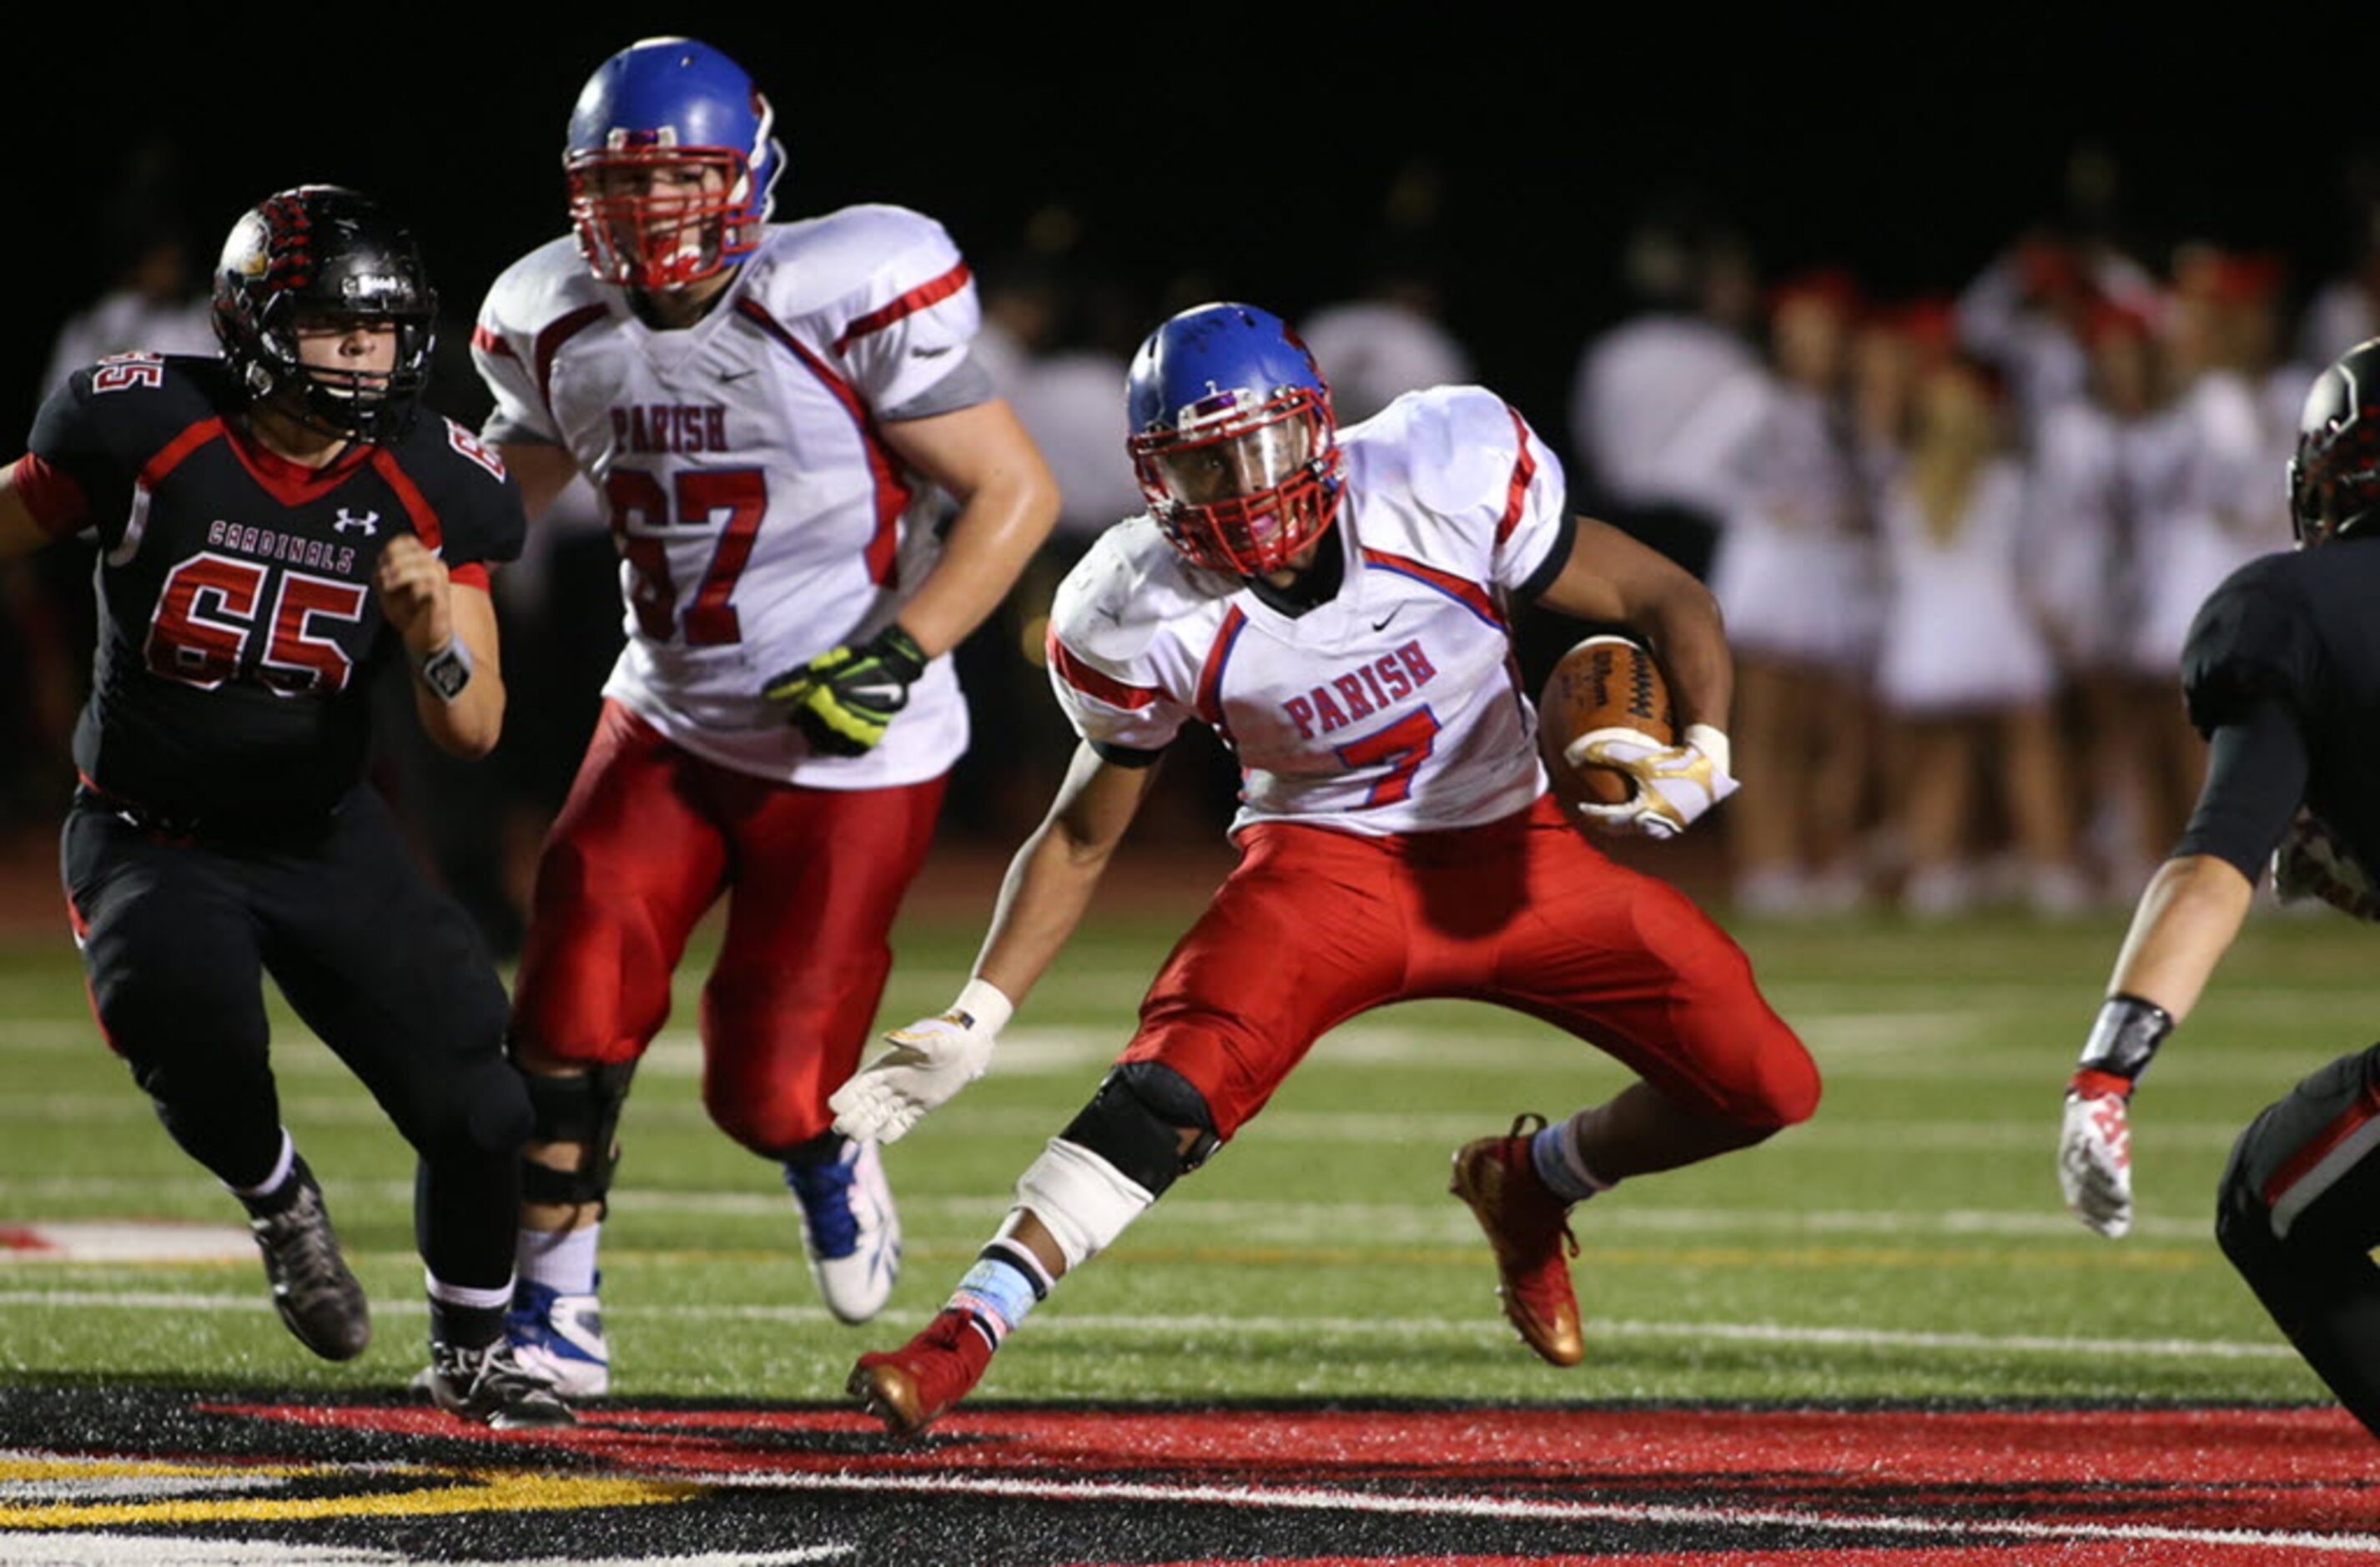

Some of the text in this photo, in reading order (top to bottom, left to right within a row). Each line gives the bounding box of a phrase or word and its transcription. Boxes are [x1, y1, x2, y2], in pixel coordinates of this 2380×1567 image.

[609, 403, 729, 454] PARISH
[208, 520, 355, 574] CARDINALS
[605, 466, 770, 648] 67
[143, 550, 369, 698] 65
[1280, 639, 1438, 740] PARISH
[1332, 701, 1443, 813] 7
